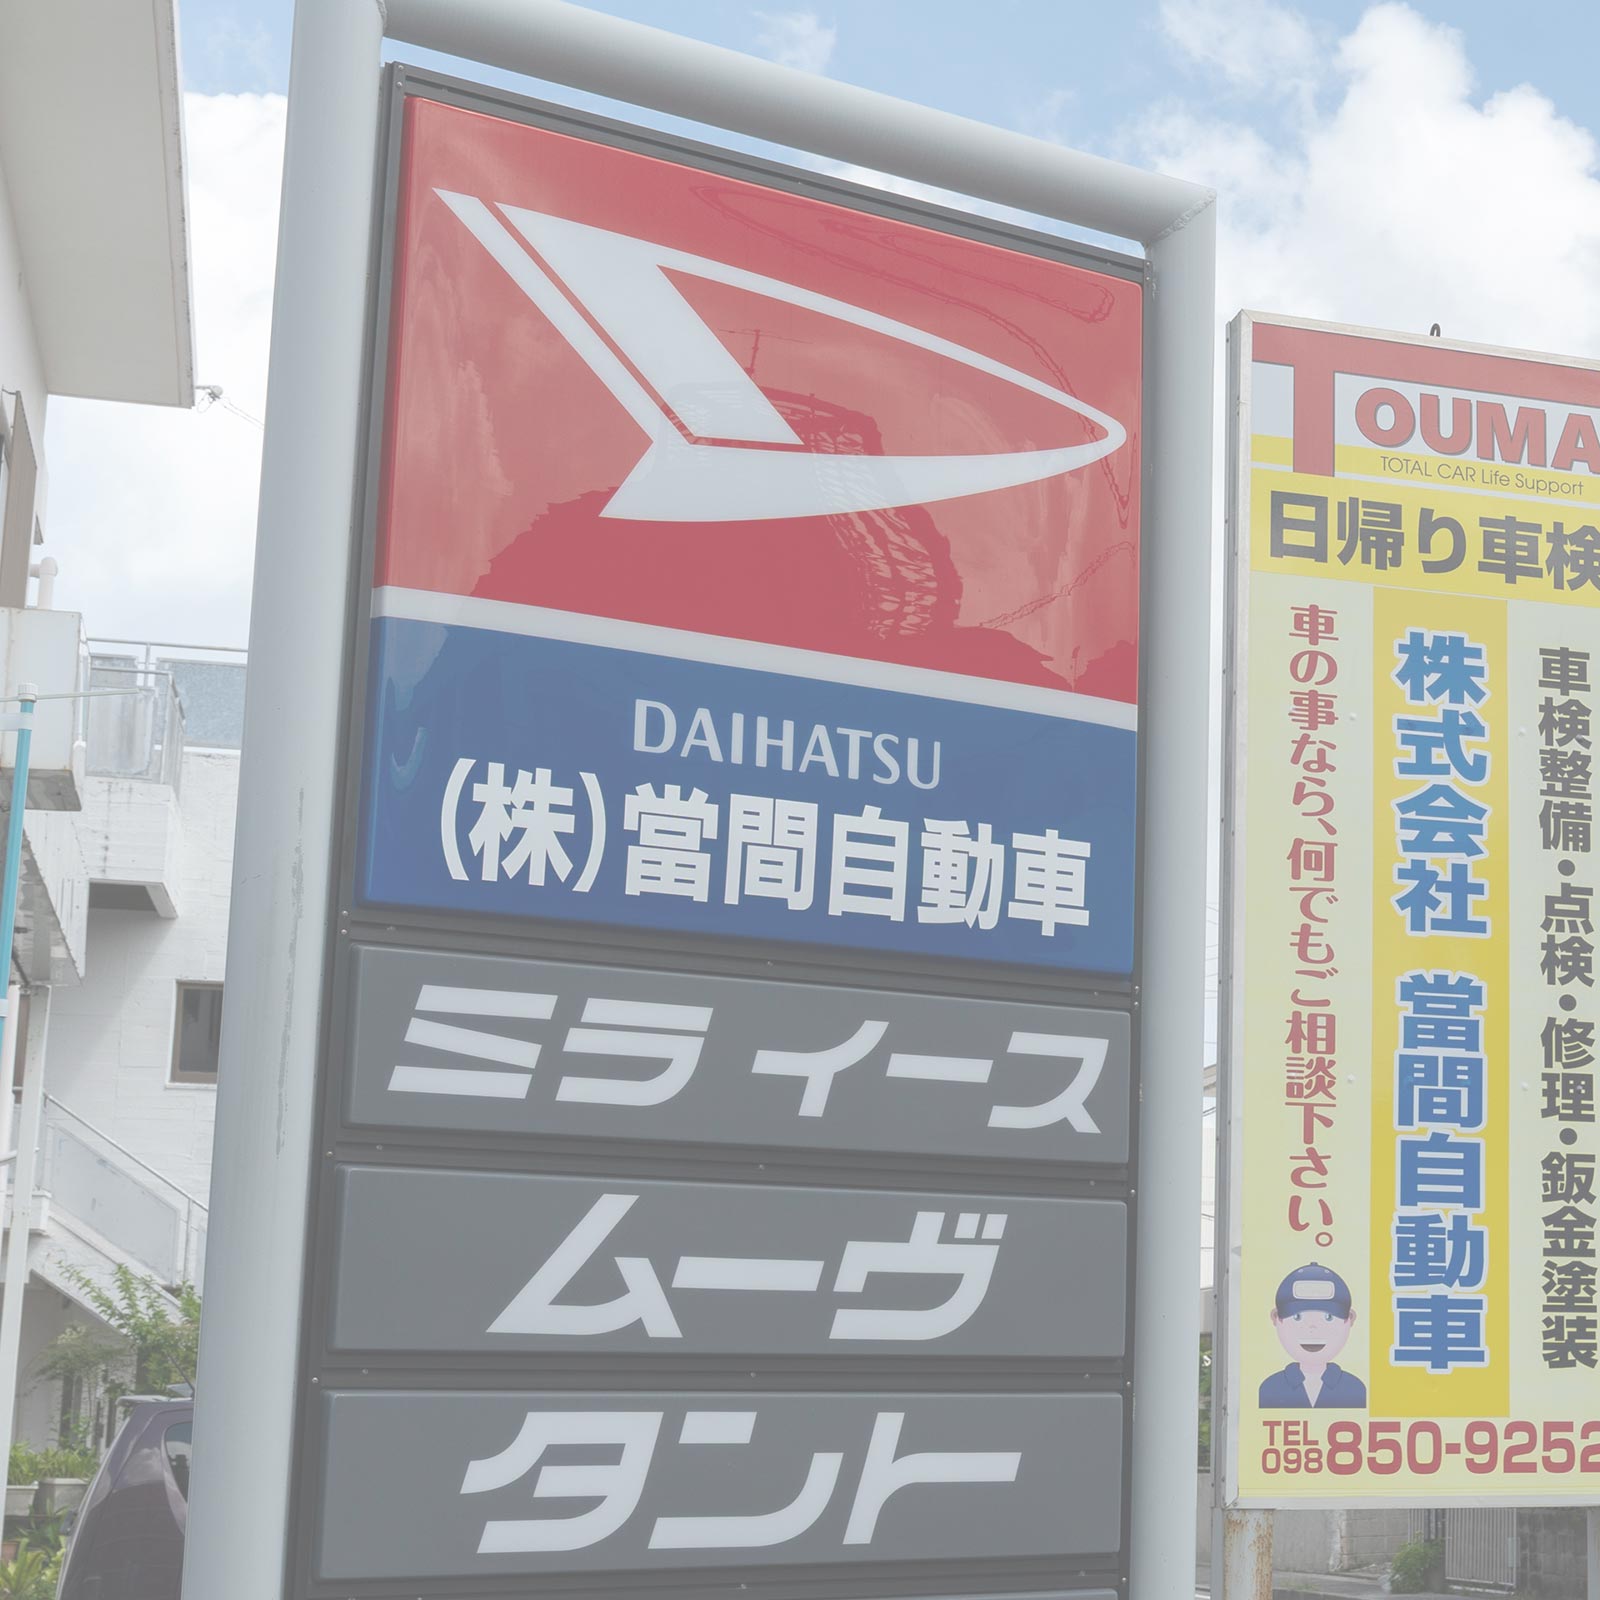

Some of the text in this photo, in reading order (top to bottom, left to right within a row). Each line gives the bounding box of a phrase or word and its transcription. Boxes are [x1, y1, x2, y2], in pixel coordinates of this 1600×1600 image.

[1380, 456, 1583, 495] TOTAL CAR Life Support
[633, 699, 941, 789] DAIHATSU
[1393, 630, 1490, 1371] 株式会社 當間自動車
[388, 985, 1108, 1133] ミラ イース
[486, 1193, 1007, 1340] ムーヴ
[460, 1411, 1021, 1553] タント
[1261, 1448, 1323, 1474] 098
[1263, 1421, 1319, 1446] TEL
